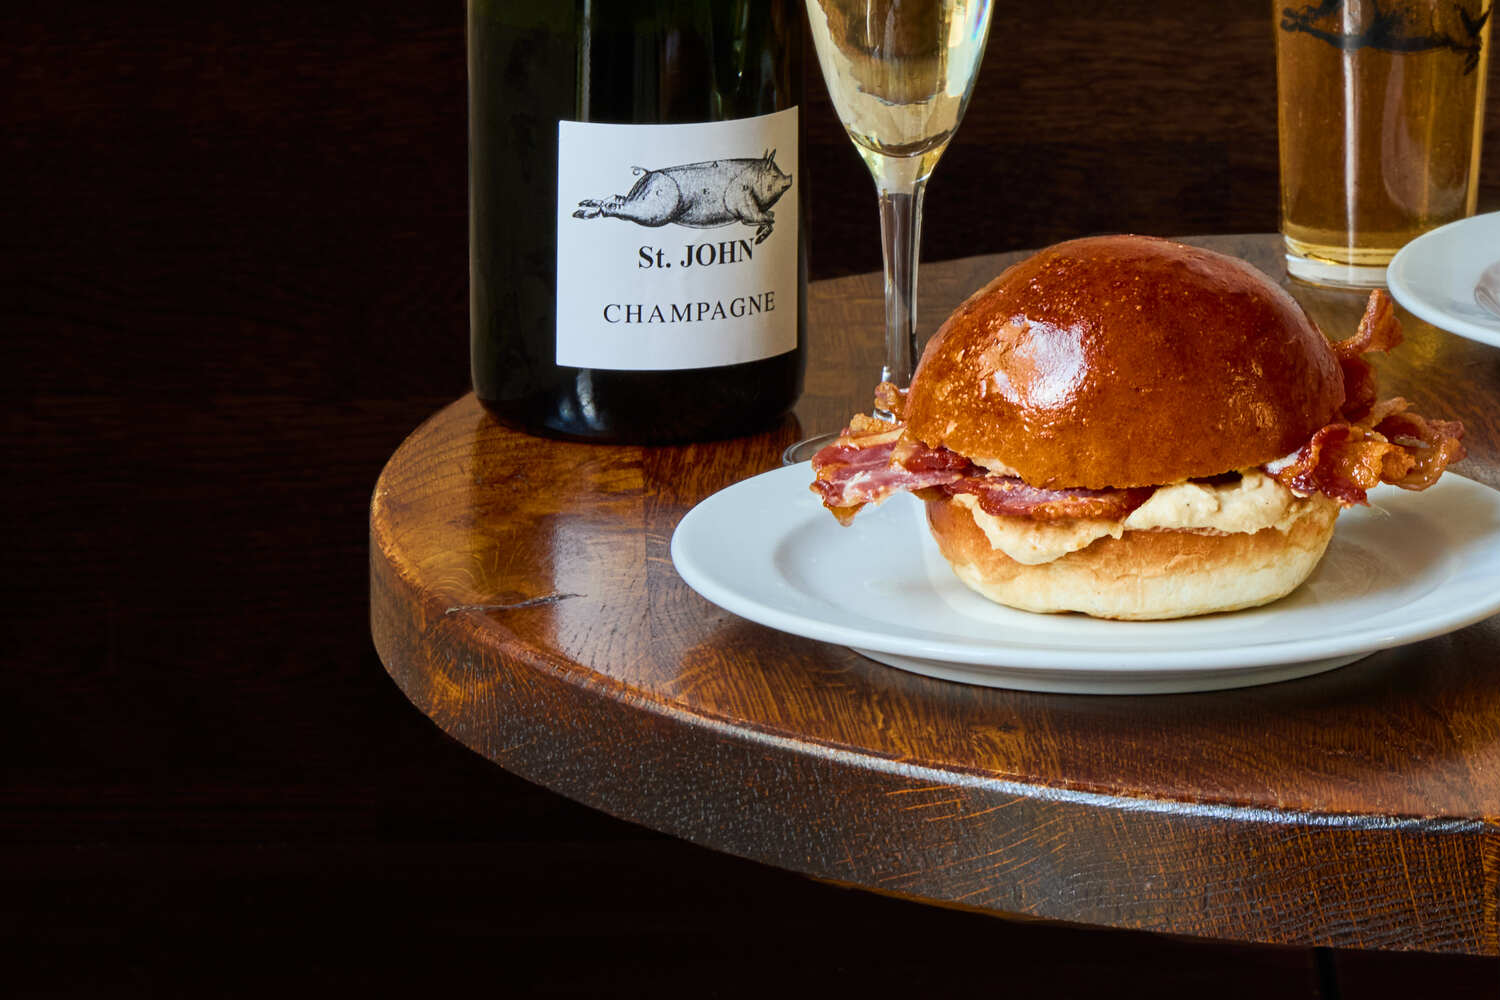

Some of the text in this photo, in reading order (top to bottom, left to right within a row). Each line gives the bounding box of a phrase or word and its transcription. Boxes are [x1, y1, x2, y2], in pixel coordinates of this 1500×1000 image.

[638, 237, 755, 269] St. JOHN
[603, 290, 776, 324] CHAMPAGNE
